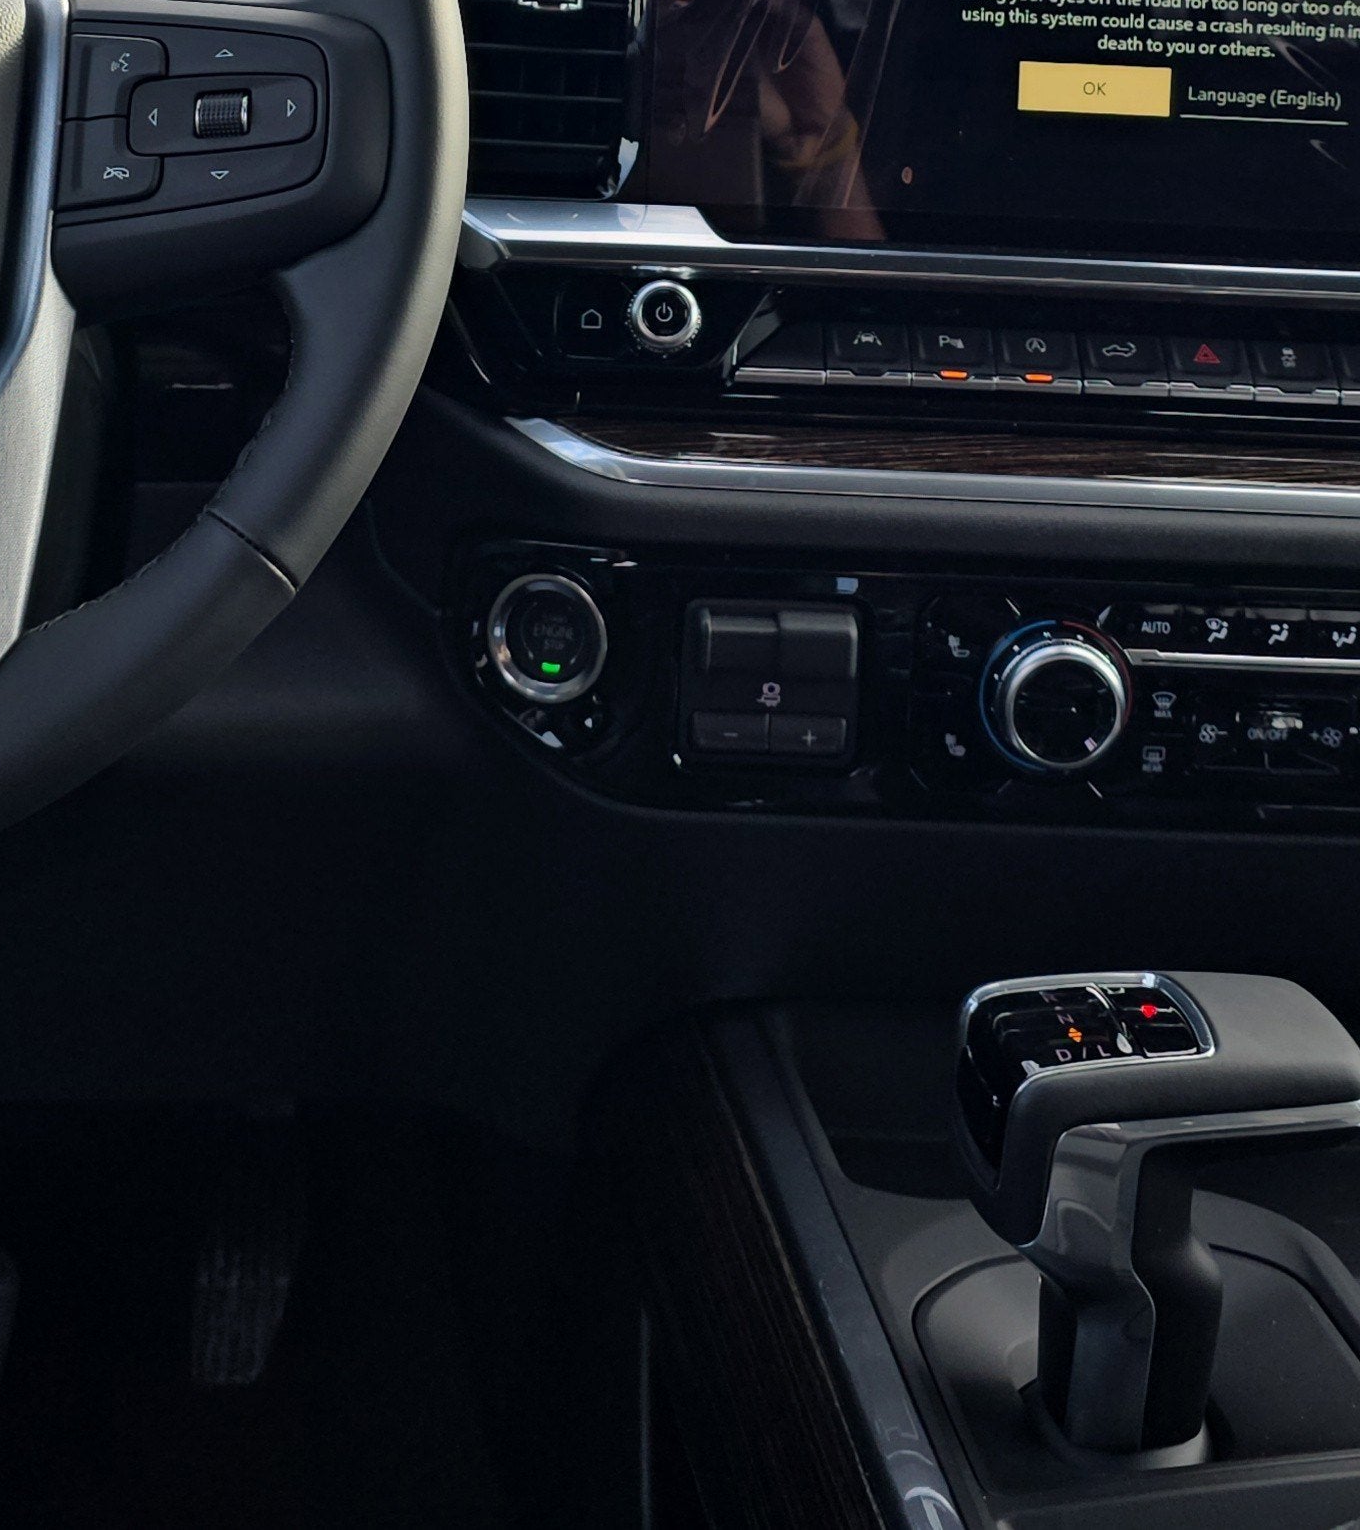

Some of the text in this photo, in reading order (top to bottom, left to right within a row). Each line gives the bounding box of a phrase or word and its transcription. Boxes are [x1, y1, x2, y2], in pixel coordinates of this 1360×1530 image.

[1281, 2, 1300, 14] or
[1302, 0, 1330, 16] too
[961, 8, 1005, 27] using
[1008, 7, 1038, 24] this
[1041, 12, 1097, 30] system
[1101, 13, 1144, 29] could
[1147, 18, 1194, 32] cause
[1196, 20, 1207, 32] a
[1210, 18, 1253, 34] crash
[1256, 20, 1326, 42] resulting
[1329, 23, 1345, 38] in
[1097, 34, 1275, 57] death to you or others.
[1083, 81, 1106, 96] OK
[1188, 86, 1341, 111] Language (English)
[1141, 620, 1171, 635] AUTO
[1246, 727, 1289, 741] ON/OFF
